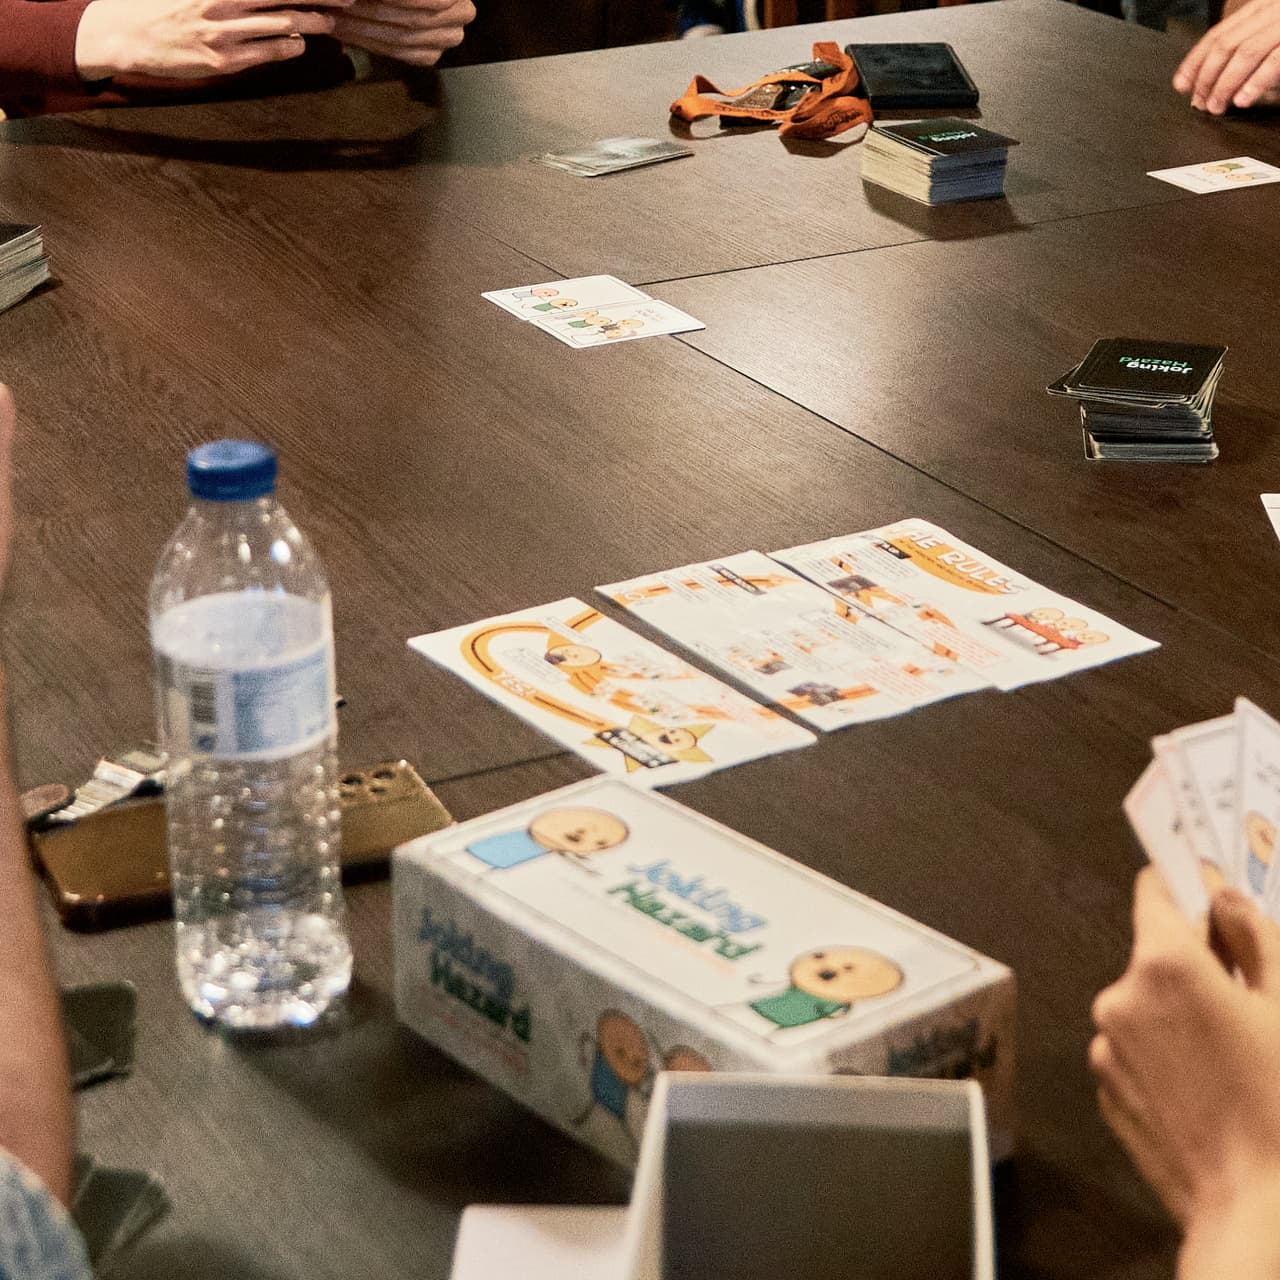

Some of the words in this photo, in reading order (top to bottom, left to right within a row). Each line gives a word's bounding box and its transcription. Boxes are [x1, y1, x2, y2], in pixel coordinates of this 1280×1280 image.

[1119, 355, 1188, 368] Hazard
[1126, 360, 1193, 374] Joking
[627, 859, 768, 933] Joking
[606, 880, 763, 960] Hazard
